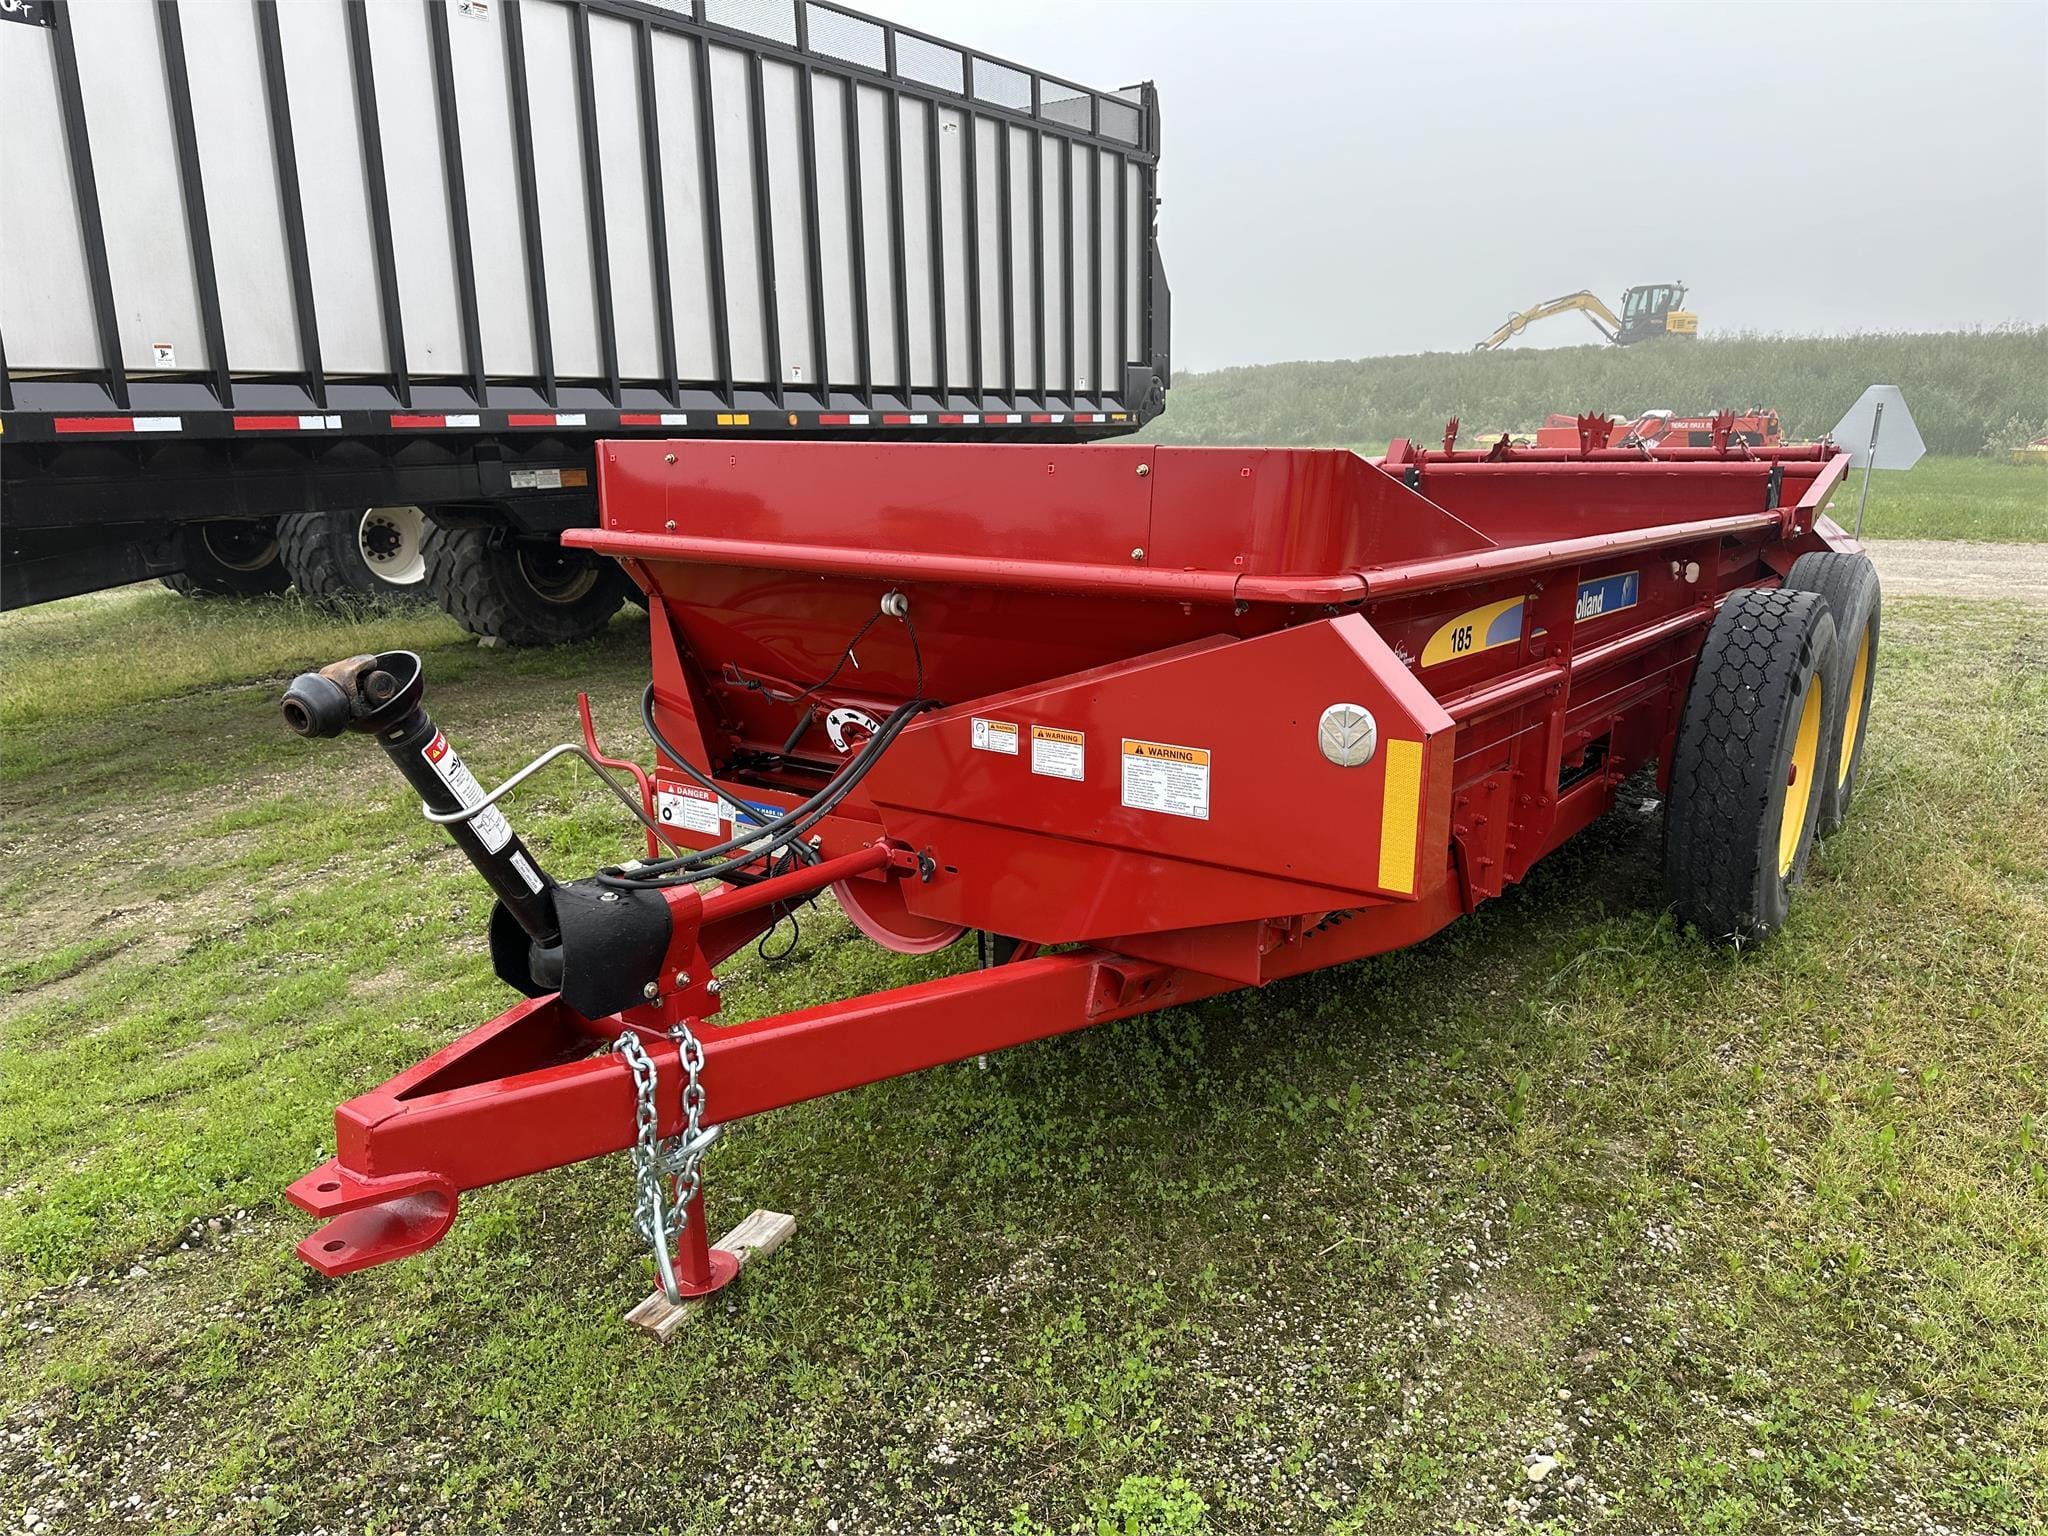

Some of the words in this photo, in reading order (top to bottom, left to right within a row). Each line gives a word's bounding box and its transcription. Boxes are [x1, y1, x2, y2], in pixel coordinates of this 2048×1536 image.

[1576, 587, 1603, 619] olland
[1451, 626, 1472, 653] 185
[1045, 731, 1078, 742] WARNING
[1148, 747, 1193, 761] WARNING
[677, 787, 709, 800] DANGER
